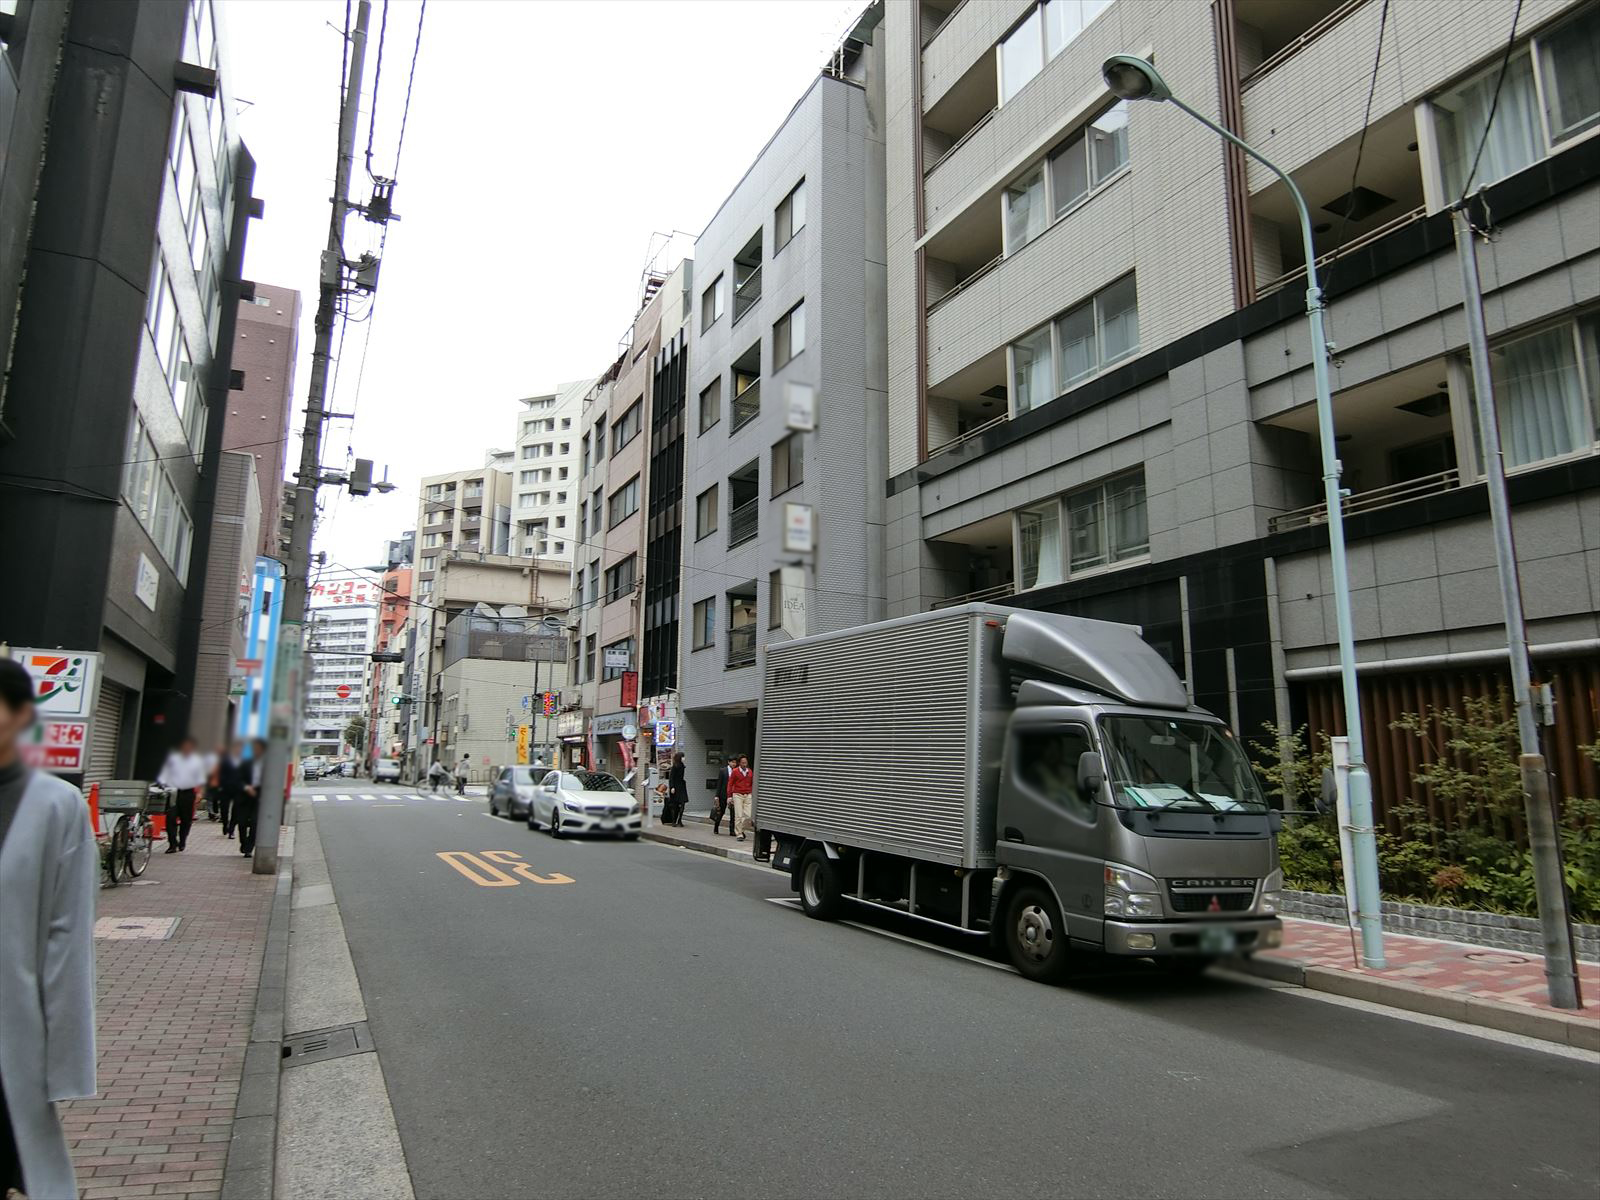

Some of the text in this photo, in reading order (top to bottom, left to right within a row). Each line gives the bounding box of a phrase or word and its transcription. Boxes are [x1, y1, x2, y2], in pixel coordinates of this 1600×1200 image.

[313, 581, 367, 596] カンコー
[784, 599, 805, 610] IDEA
[1171, 879, 1255, 887] CANTER
